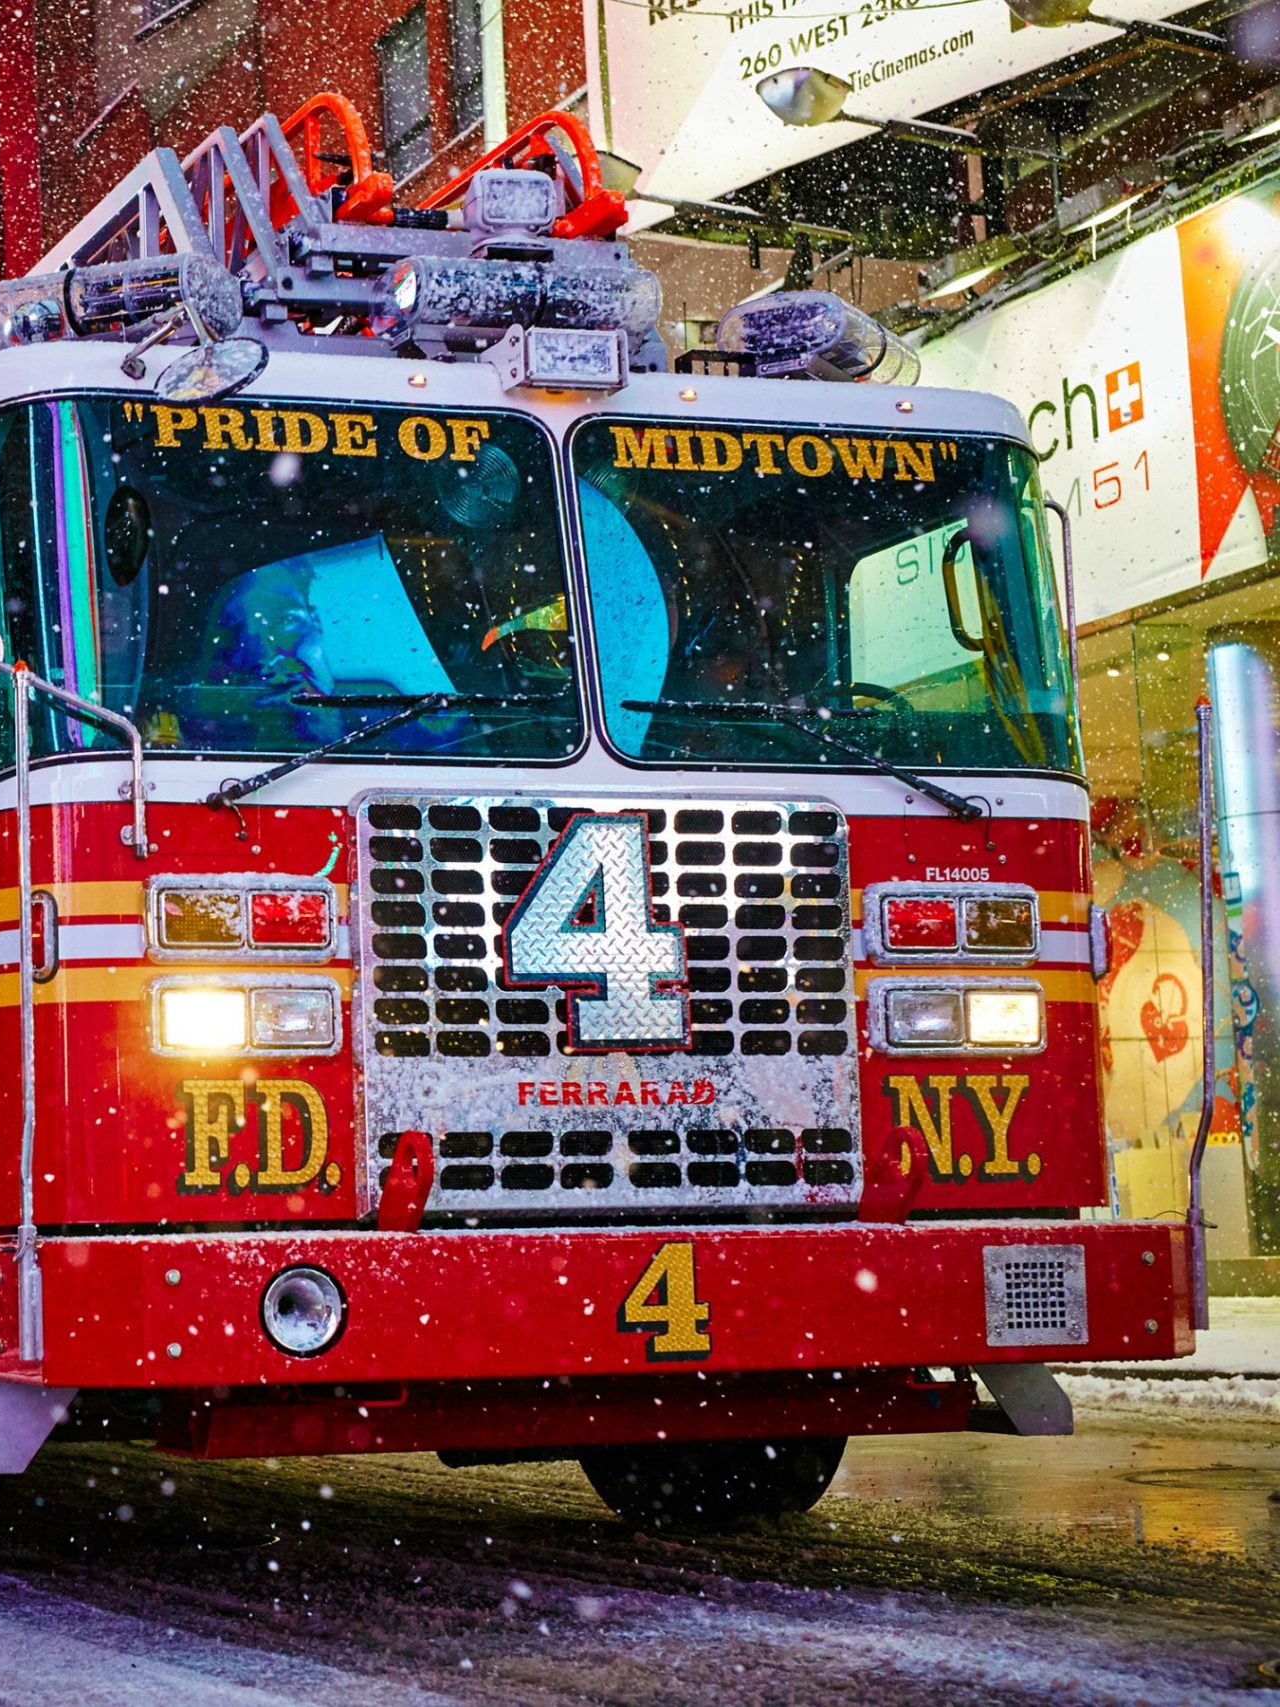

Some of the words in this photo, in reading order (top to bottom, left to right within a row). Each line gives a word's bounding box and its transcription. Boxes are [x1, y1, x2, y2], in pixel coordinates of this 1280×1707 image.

[740, 43, 782, 80] 260
[789, 15, 849, 57] WEST
[122, 401, 378, 458] "PRIDE
[397, 416, 491, 462] OF
[609, 425, 959, 483] MIDTOWN"
[925, 867, 990, 881] FL14005
[502, 811, 693, 1051] 4
[180, 1079, 342, 1190] F.D.
[517, 1081, 688, 1106] FERRARA
[886, 1073, 1042, 1178] N.Y.
[622, 1242, 711, 1354] 4
